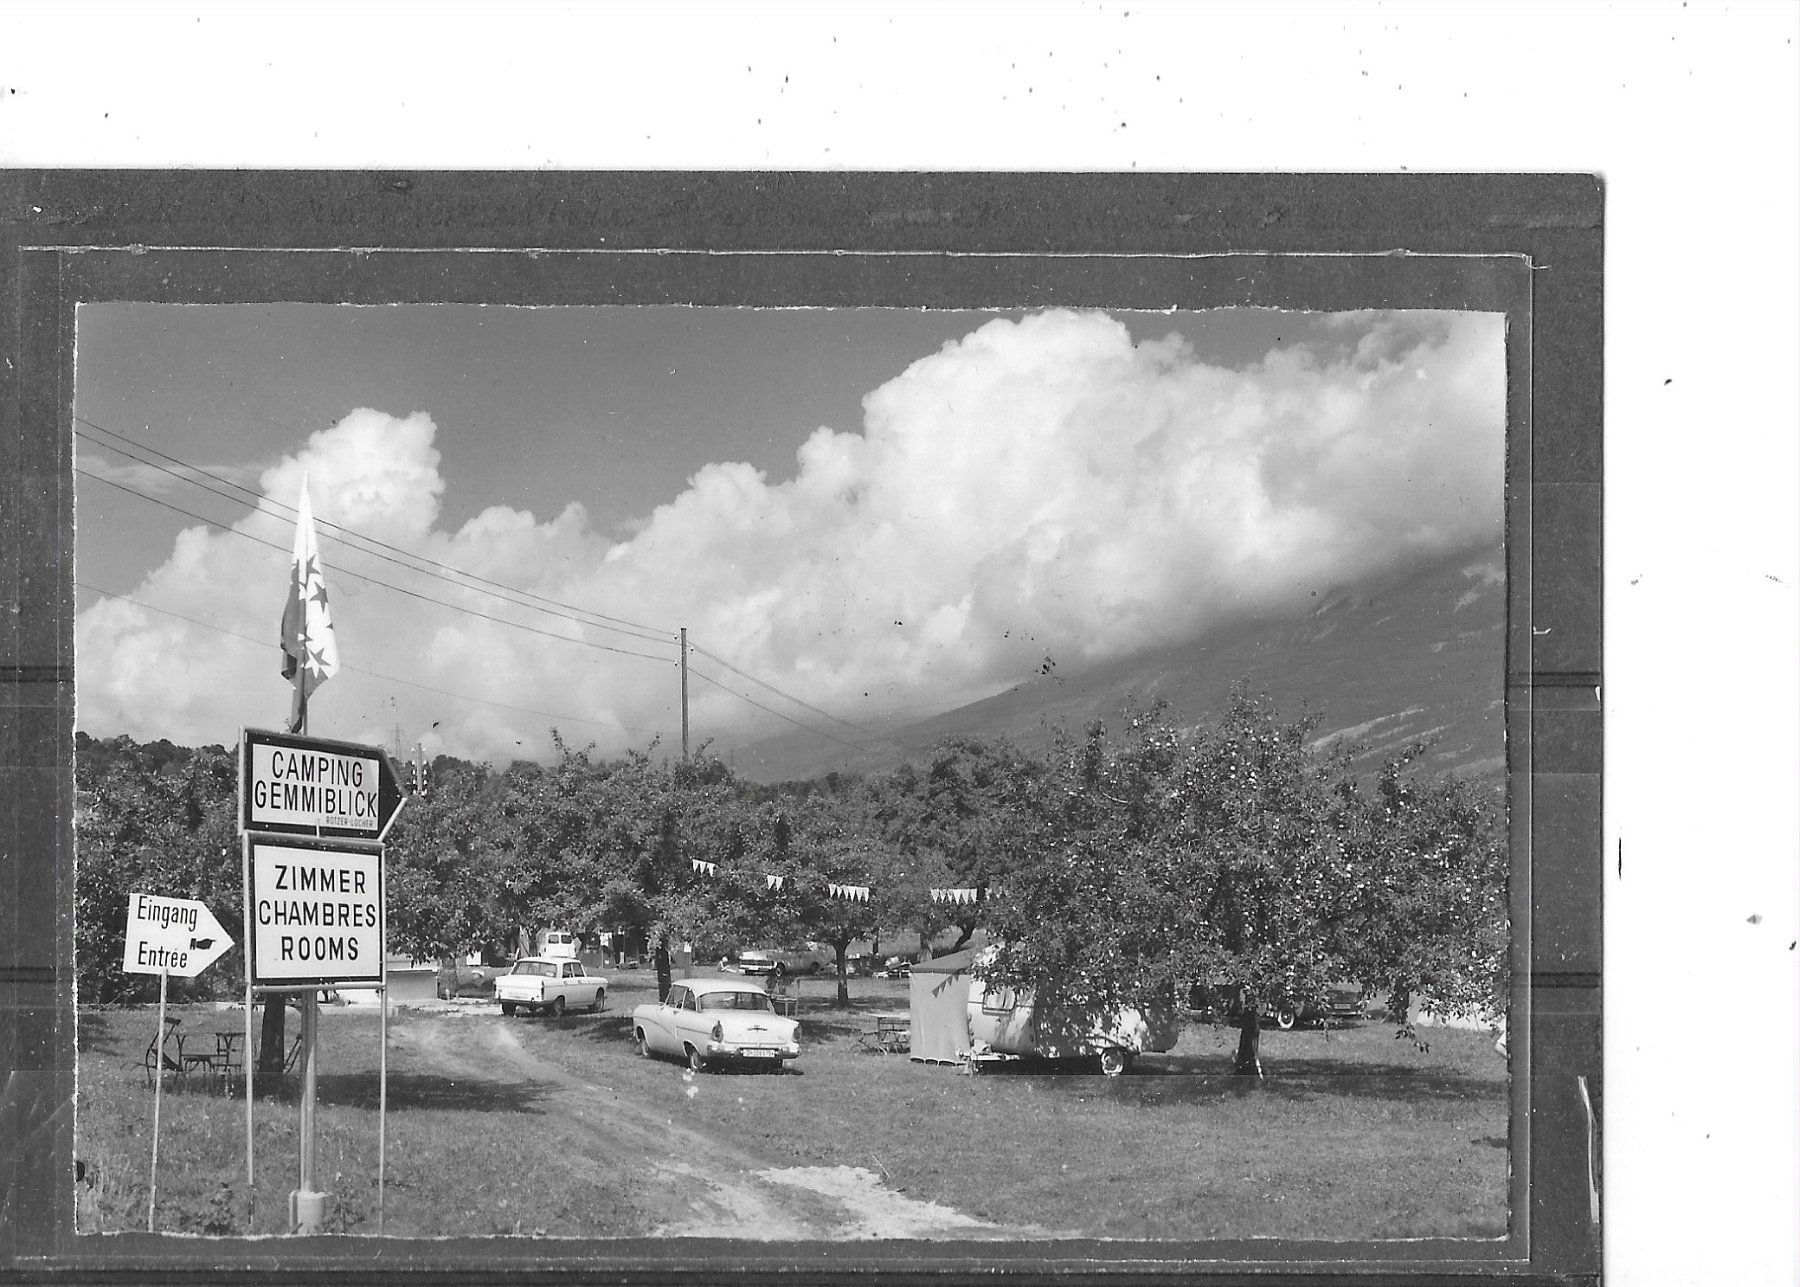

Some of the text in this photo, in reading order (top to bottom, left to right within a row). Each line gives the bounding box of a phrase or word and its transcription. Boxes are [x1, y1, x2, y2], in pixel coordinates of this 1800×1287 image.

[272, 750, 363, 788] CAMPING
[254, 780, 378, 818] GEMMIBLICK
[274, 865, 366, 894] ZIMMER
[137, 895, 198, 932] Eingang
[258, 900, 376, 928] CHAMBRES
[281, 936, 359, 961] ROOMS
